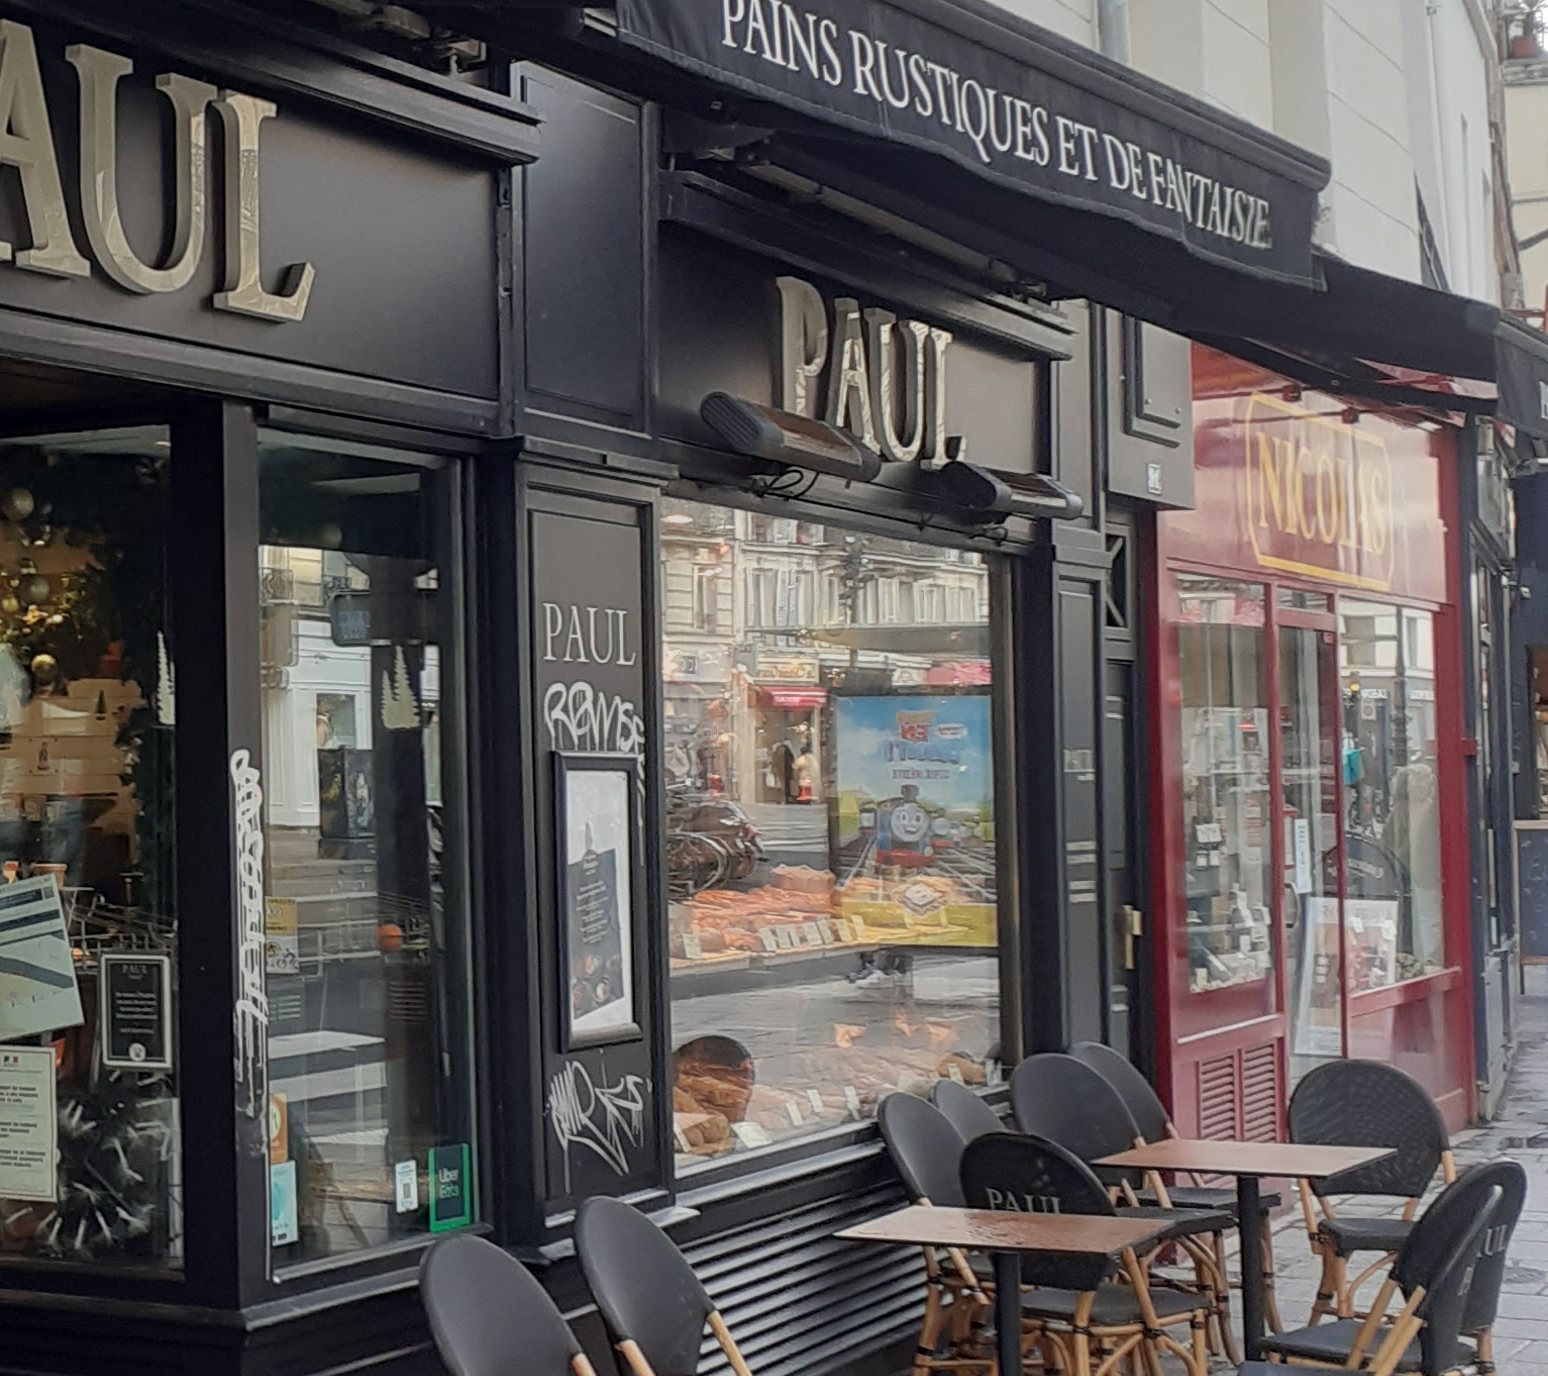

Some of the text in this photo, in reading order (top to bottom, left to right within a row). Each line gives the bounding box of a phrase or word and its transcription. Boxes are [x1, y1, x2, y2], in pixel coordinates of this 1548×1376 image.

[848, 29, 1050, 166] RUSTIQUES
[1055, 115, 1099, 181] ET
[1102, 133, 1148, 200] DE
[1146, 151, 1274, 249] FANTAISIE
[776, 276, 967, 470] PAUL
[542, 602, 637, 666] PAUL
[438, 1167, 460, 1183] Uber
[439, 1184, 460, 1199] Eats
